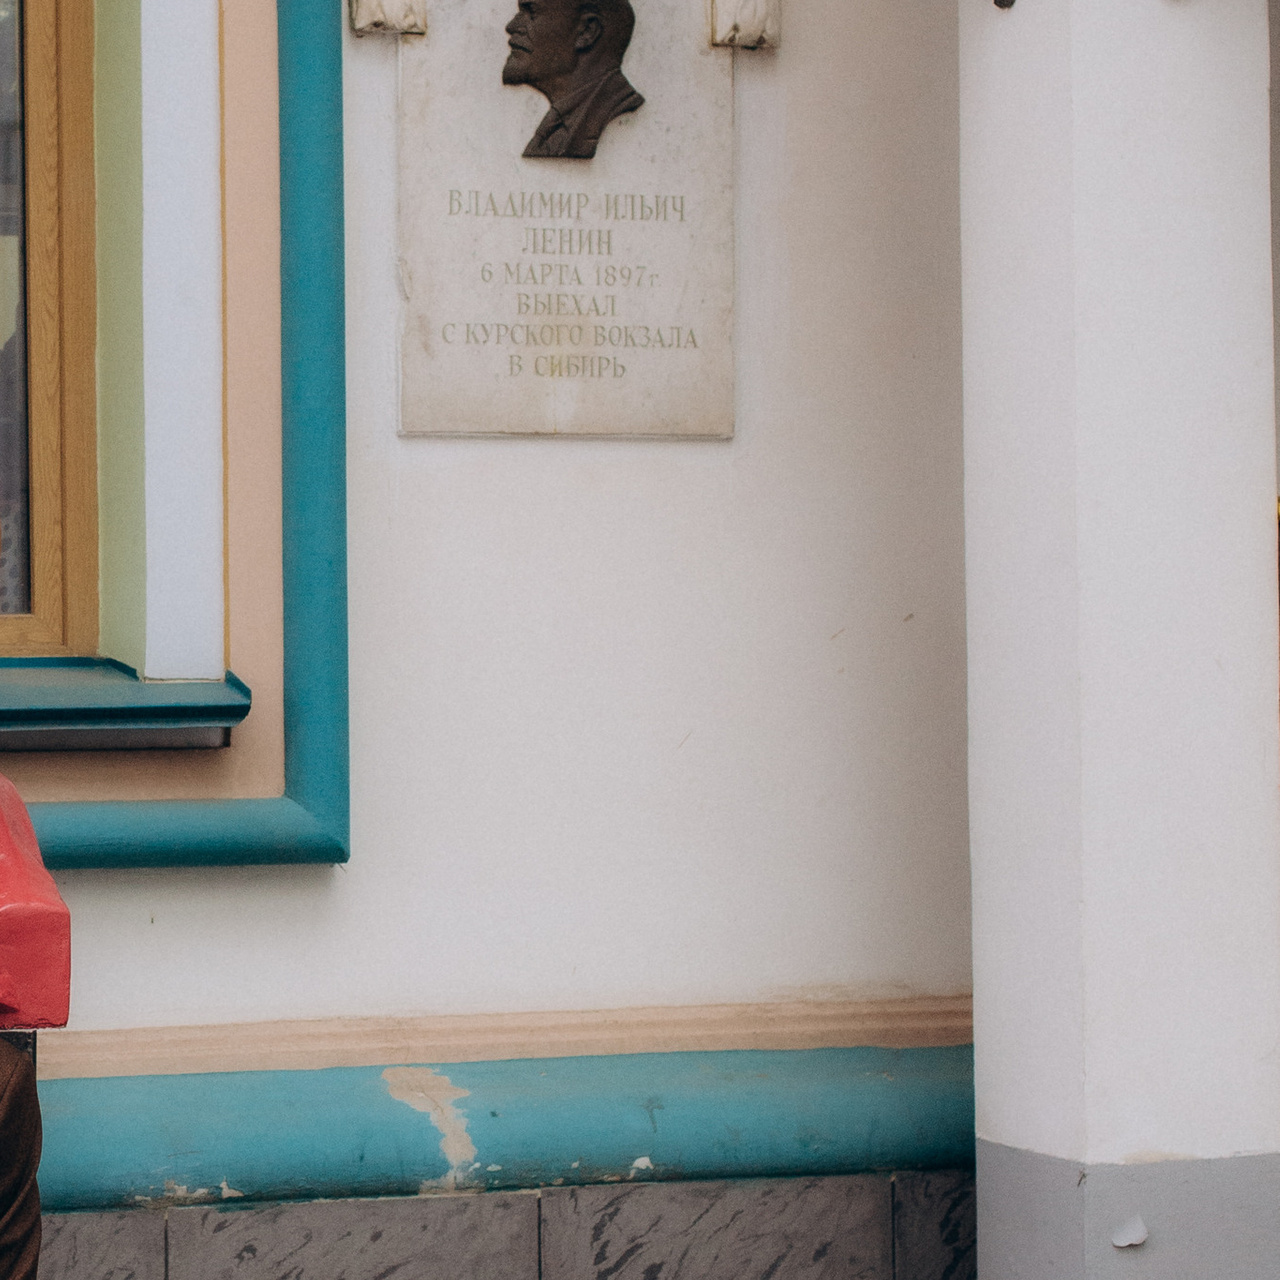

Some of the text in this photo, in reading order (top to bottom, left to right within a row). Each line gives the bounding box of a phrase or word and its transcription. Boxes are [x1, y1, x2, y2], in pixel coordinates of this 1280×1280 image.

[447, 188, 687, 222] ВЛАДИМИР ИЛЬИЧ
[522, 227, 613, 256] ЛЕНИН
[480, 263, 494, 284] 6
[504, 262, 583, 287] МАРТА
[517, 292, 618, 317] ВЫЕХАЛ
[441, 322, 699, 350] С КУРСКОГО ВОКЗАЛА
[508, 354, 626, 379] В СИБИРЬ
